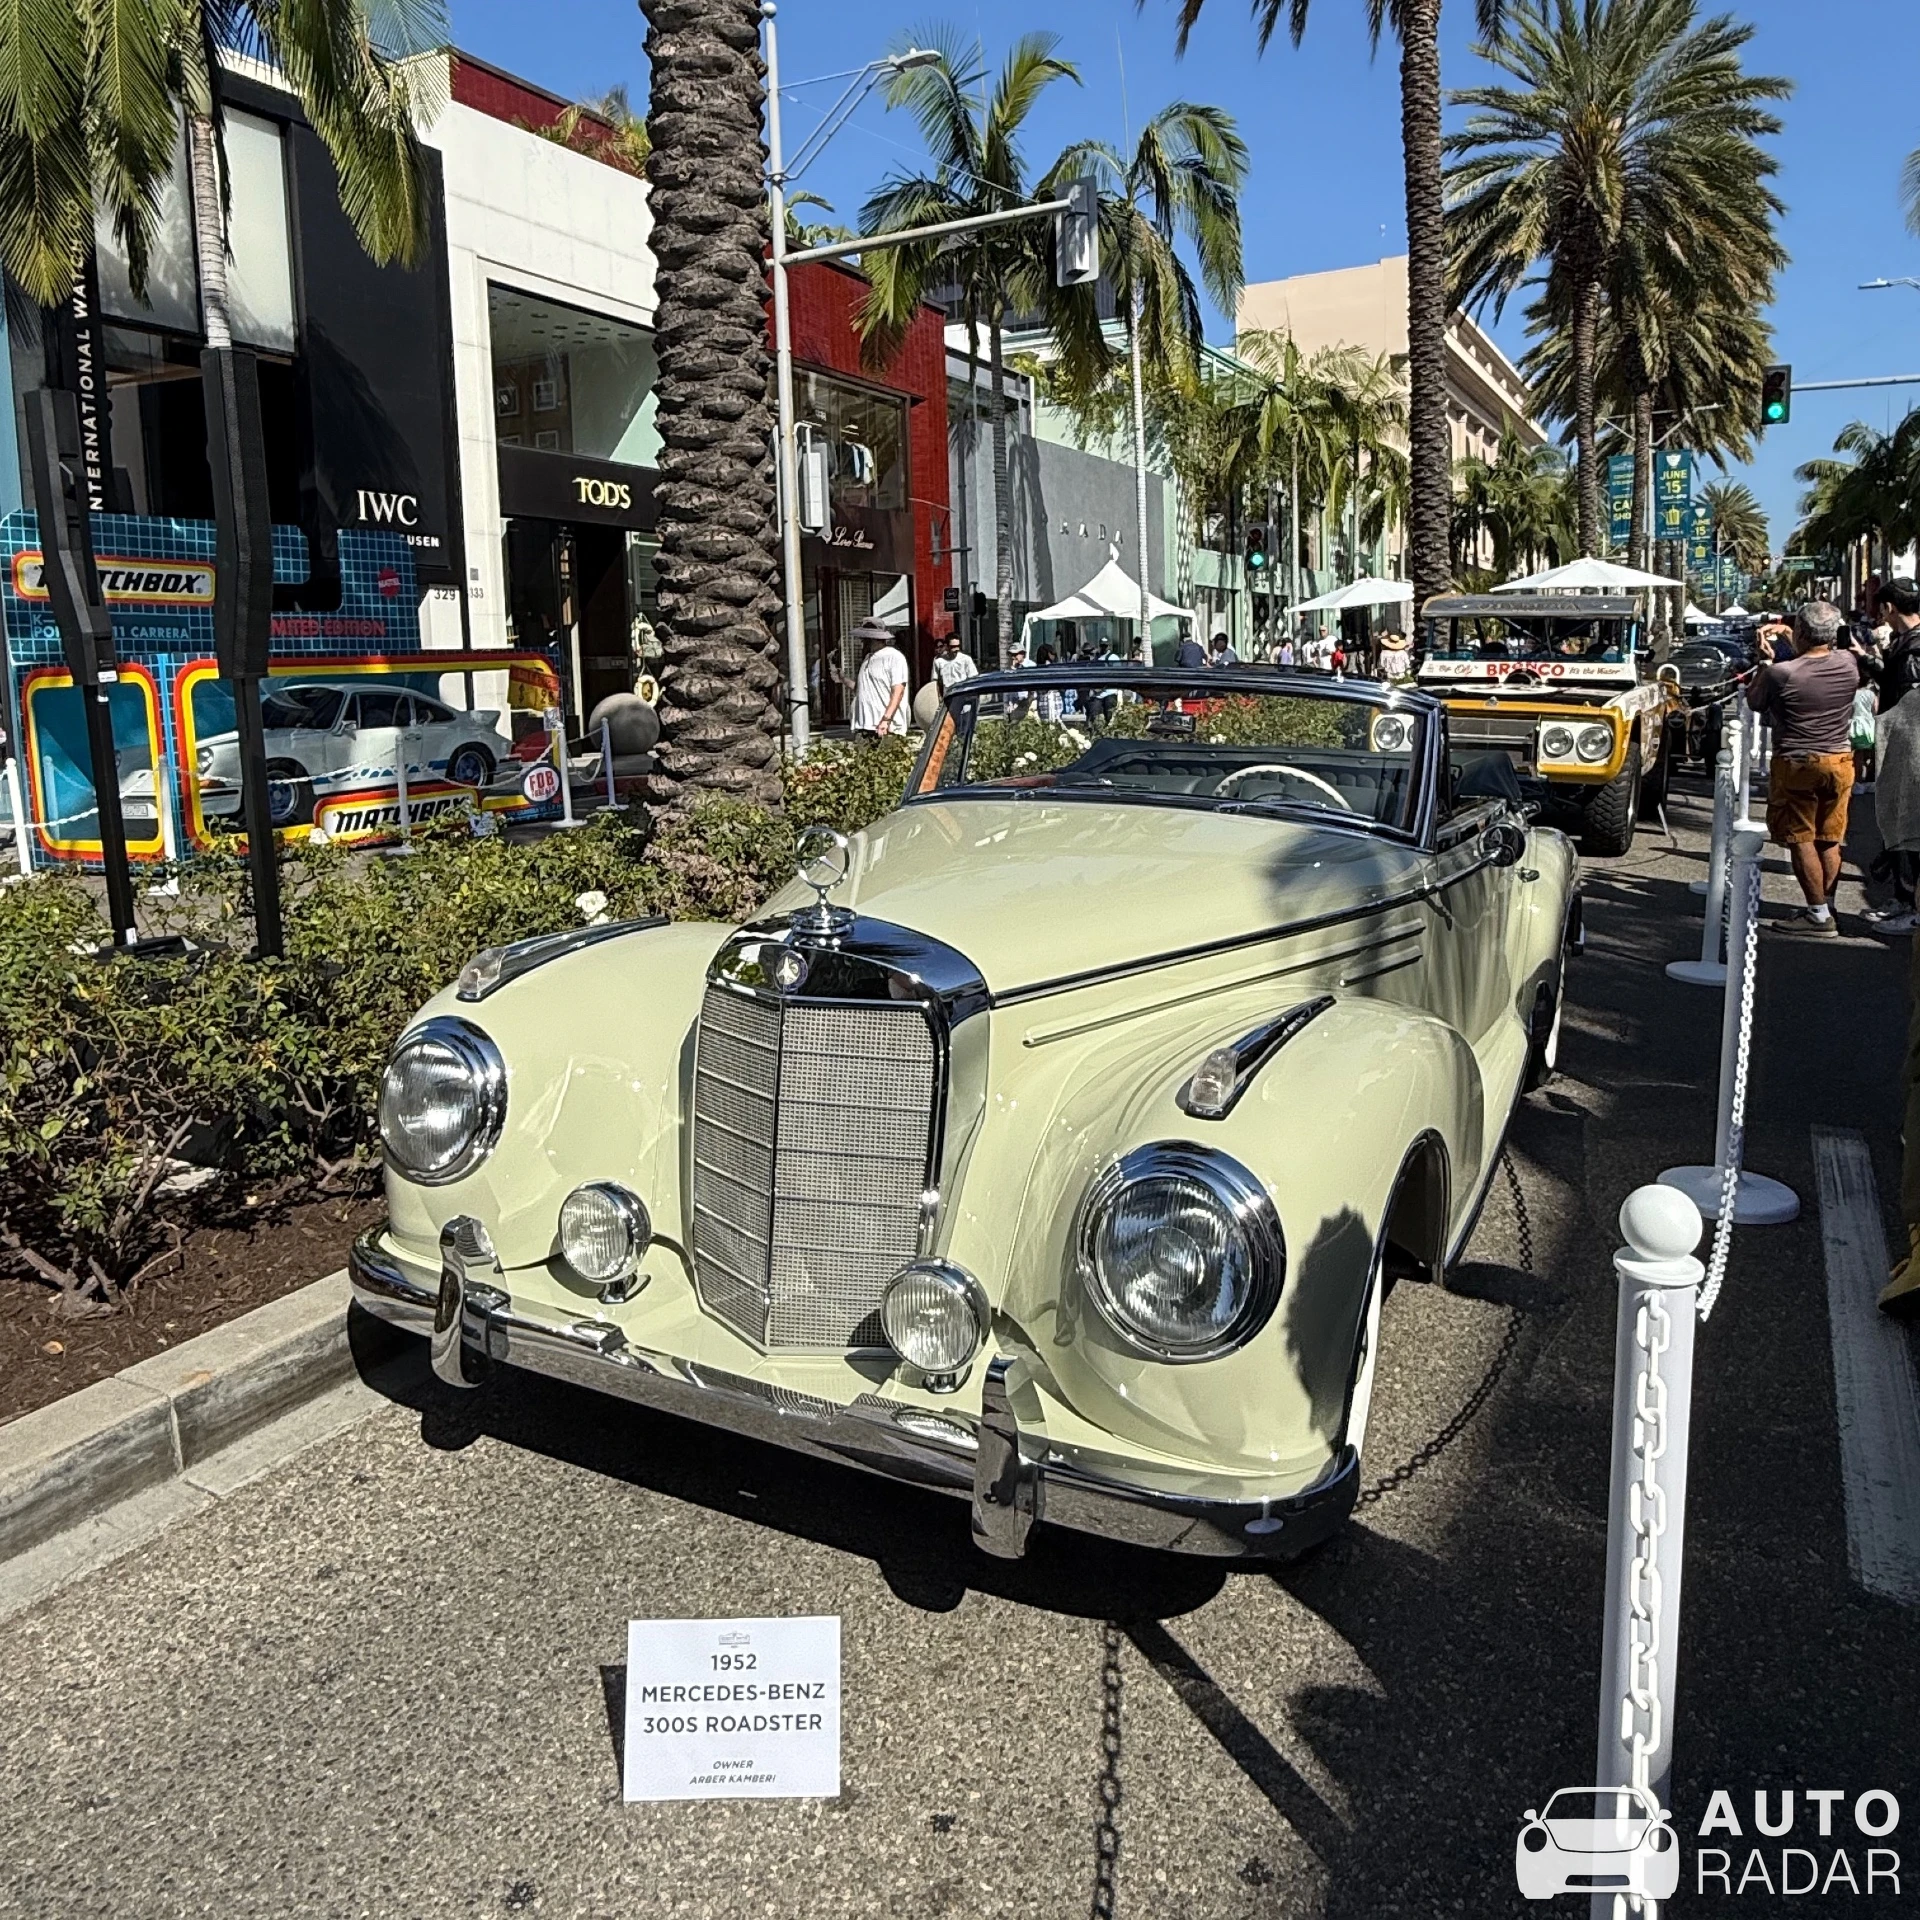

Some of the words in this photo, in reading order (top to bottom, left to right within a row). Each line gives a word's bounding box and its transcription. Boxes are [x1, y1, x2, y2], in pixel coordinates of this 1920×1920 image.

[76, 329, 104, 511] NTERNATIONAL
[1659, 469, 1688, 480] JUNE
[572, 477, 631, 509] TOD'S
[1665, 481, 1682, 494] 15
[357, 489, 418, 526] IWC
[1060, 521, 1123, 544] RADA
[434, 587, 456, 601] 329
[131, 626, 190, 639] CARRERA
[271, 619, 320, 636] MITED
[1486, 661, 1565, 676] BRONCO
[710, 1653, 757, 1671] 1952
[641, 1683, 826, 1703] MERCEDES-BENZ
[643, 1717, 698, 1733] 300S
[706, 1714, 822, 1732] ROADSTER
[712, 1760, 754, 1770] OWNER
[728, 1774, 777, 1784] KAMBERI
